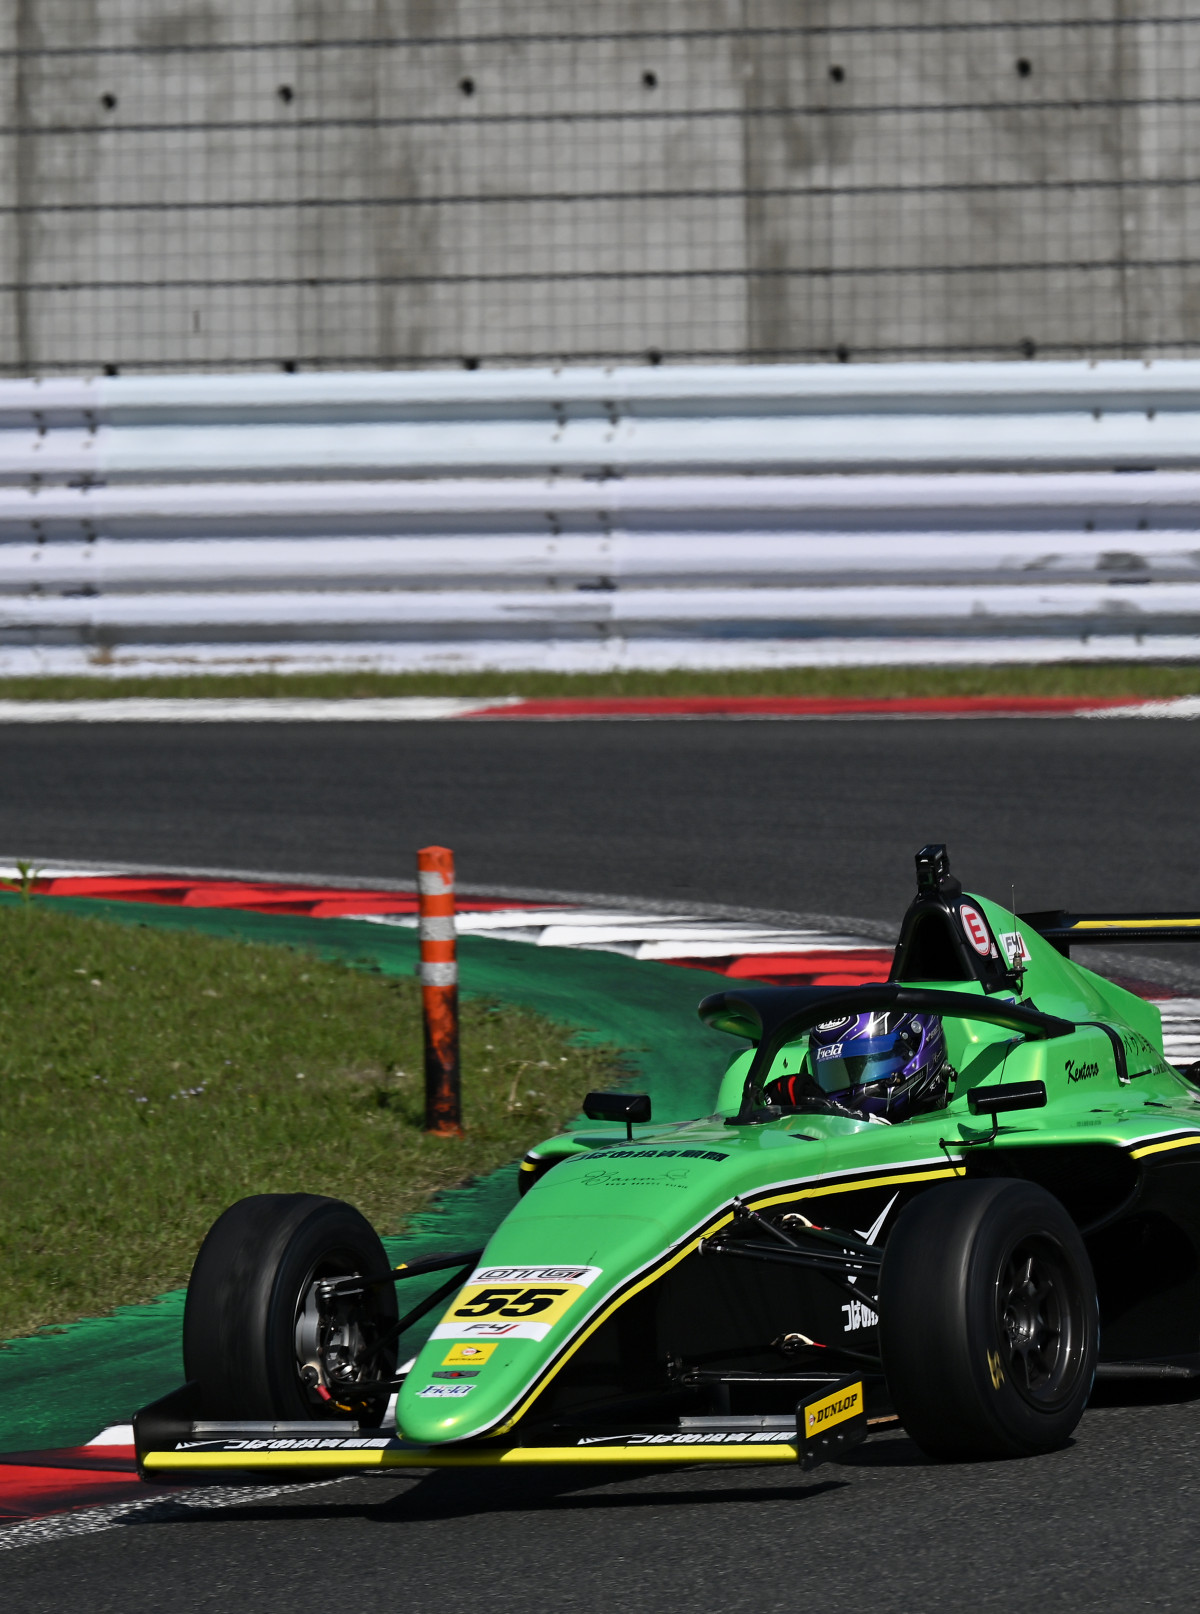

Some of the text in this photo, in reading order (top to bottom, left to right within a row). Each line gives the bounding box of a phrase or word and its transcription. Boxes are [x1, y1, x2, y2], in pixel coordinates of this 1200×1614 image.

[965, 913, 986, 944] E
[1065, 1059, 1099, 1084] Kentaro
[454, 1288, 569, 1317] 55
[816, 1393, 858, 1423] DUNLOP
